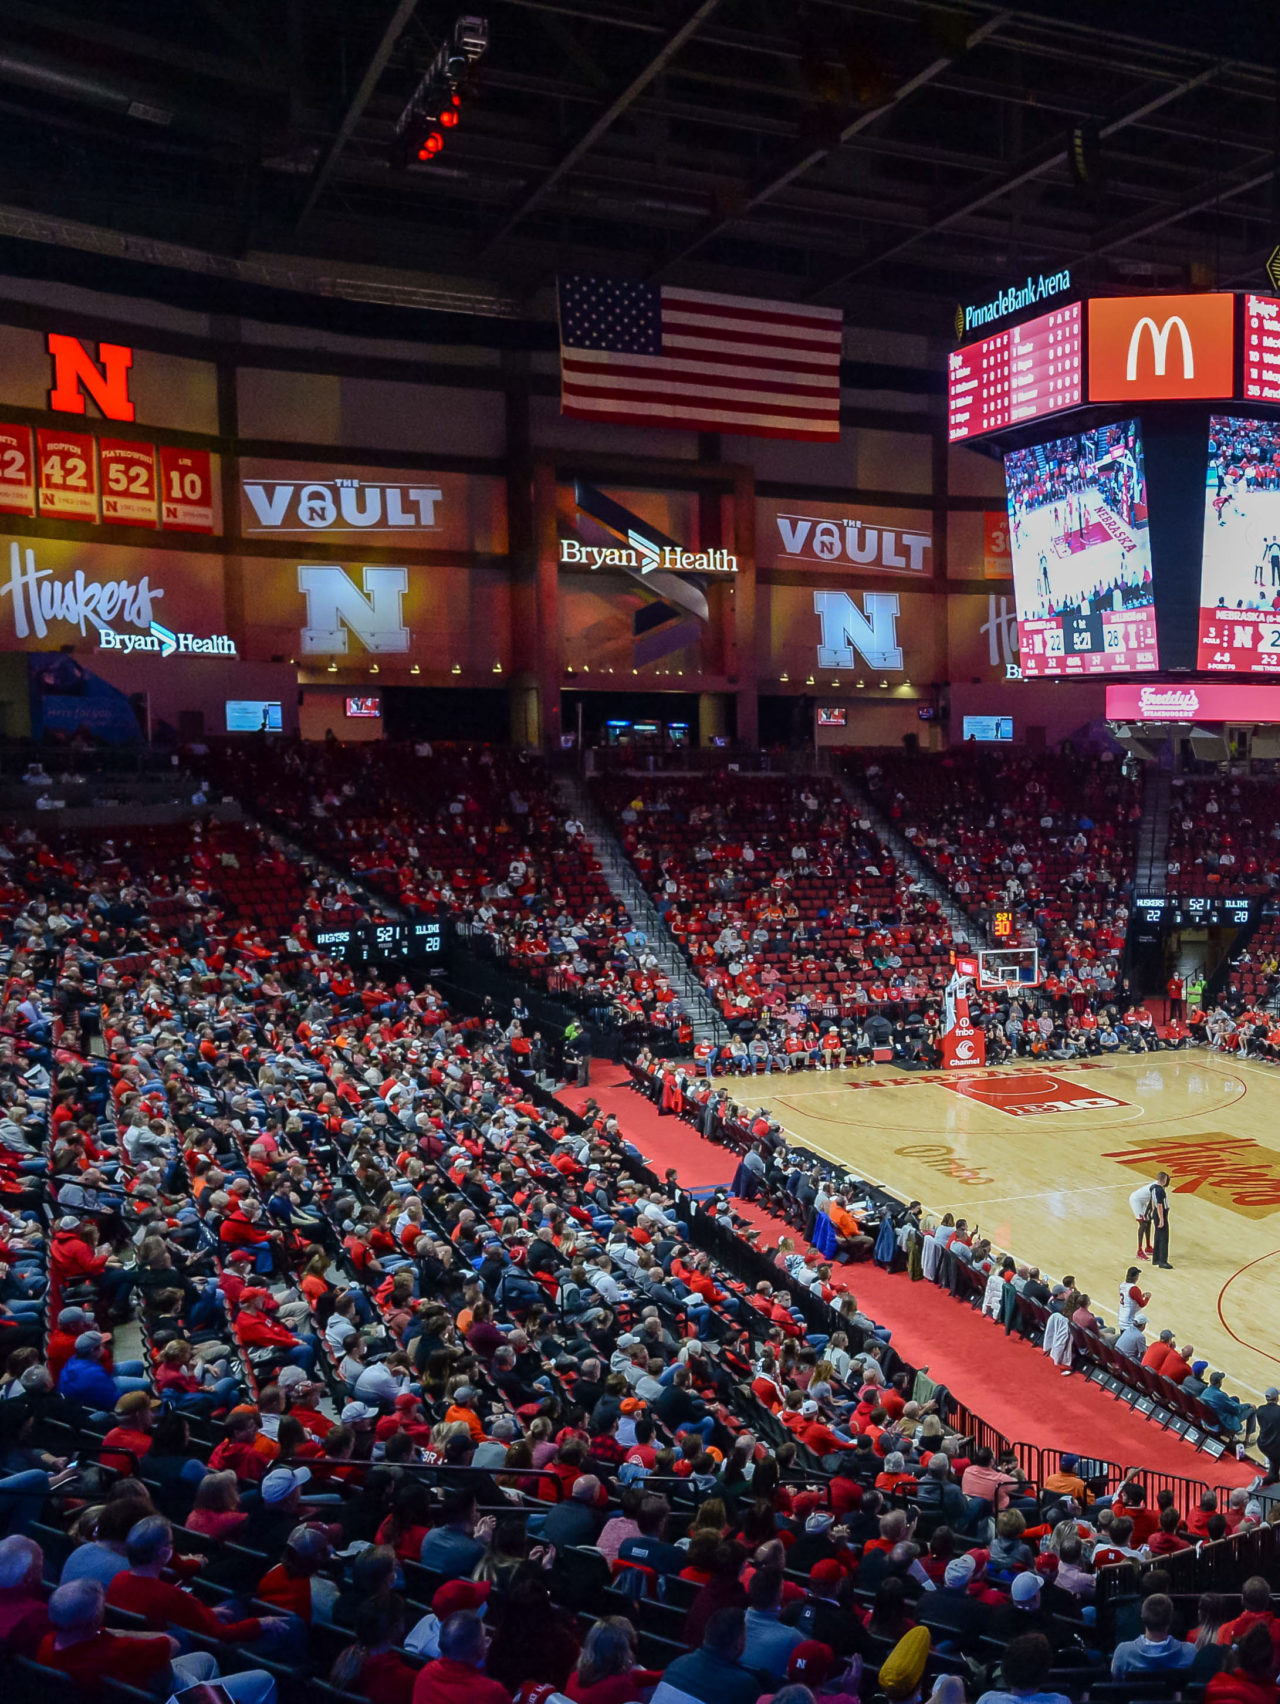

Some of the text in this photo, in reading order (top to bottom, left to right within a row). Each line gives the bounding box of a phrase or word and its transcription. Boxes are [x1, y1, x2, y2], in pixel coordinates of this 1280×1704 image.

[1036, 269, 1070, 300] Arena
[48, 333, 135, 422] N
[44, 455, 87, 487] 42
[108, 463, 150, 495] 52
[170, 471, 202, 500] 10
[335, 478, 360, 488] THE
[42, 493, 55, 506] N
[105, 500, 118, 513] N
[166, 507, 178, 519] N
[843, 518, 863, 529] THE
[560, 539, 738, 573] Bryan Health
[0, 541, 164, 639] Huskers
[297, 565, 410, 654] N
[813, 590, 904, 671] N
[1209, 627, 1215, 637] 3
[1233, 626, 1253, 648] N
[100, 628, 237, 655] Bryan Health
[1050, 635, 1061, 650] 22
[1108, 631, 1118, 647] 28
[1262, 655, 1277, 664] 2-2
[1147, 910, 1248, 922] 22 28
[995, 921, 1011, 936] 30
[426, 937, 440, 951] 28
[955, 1027, 974, 1037] fnbo
[950, 1058, 980, 1066] Channel
[796, 1658, 806, 1669] N
